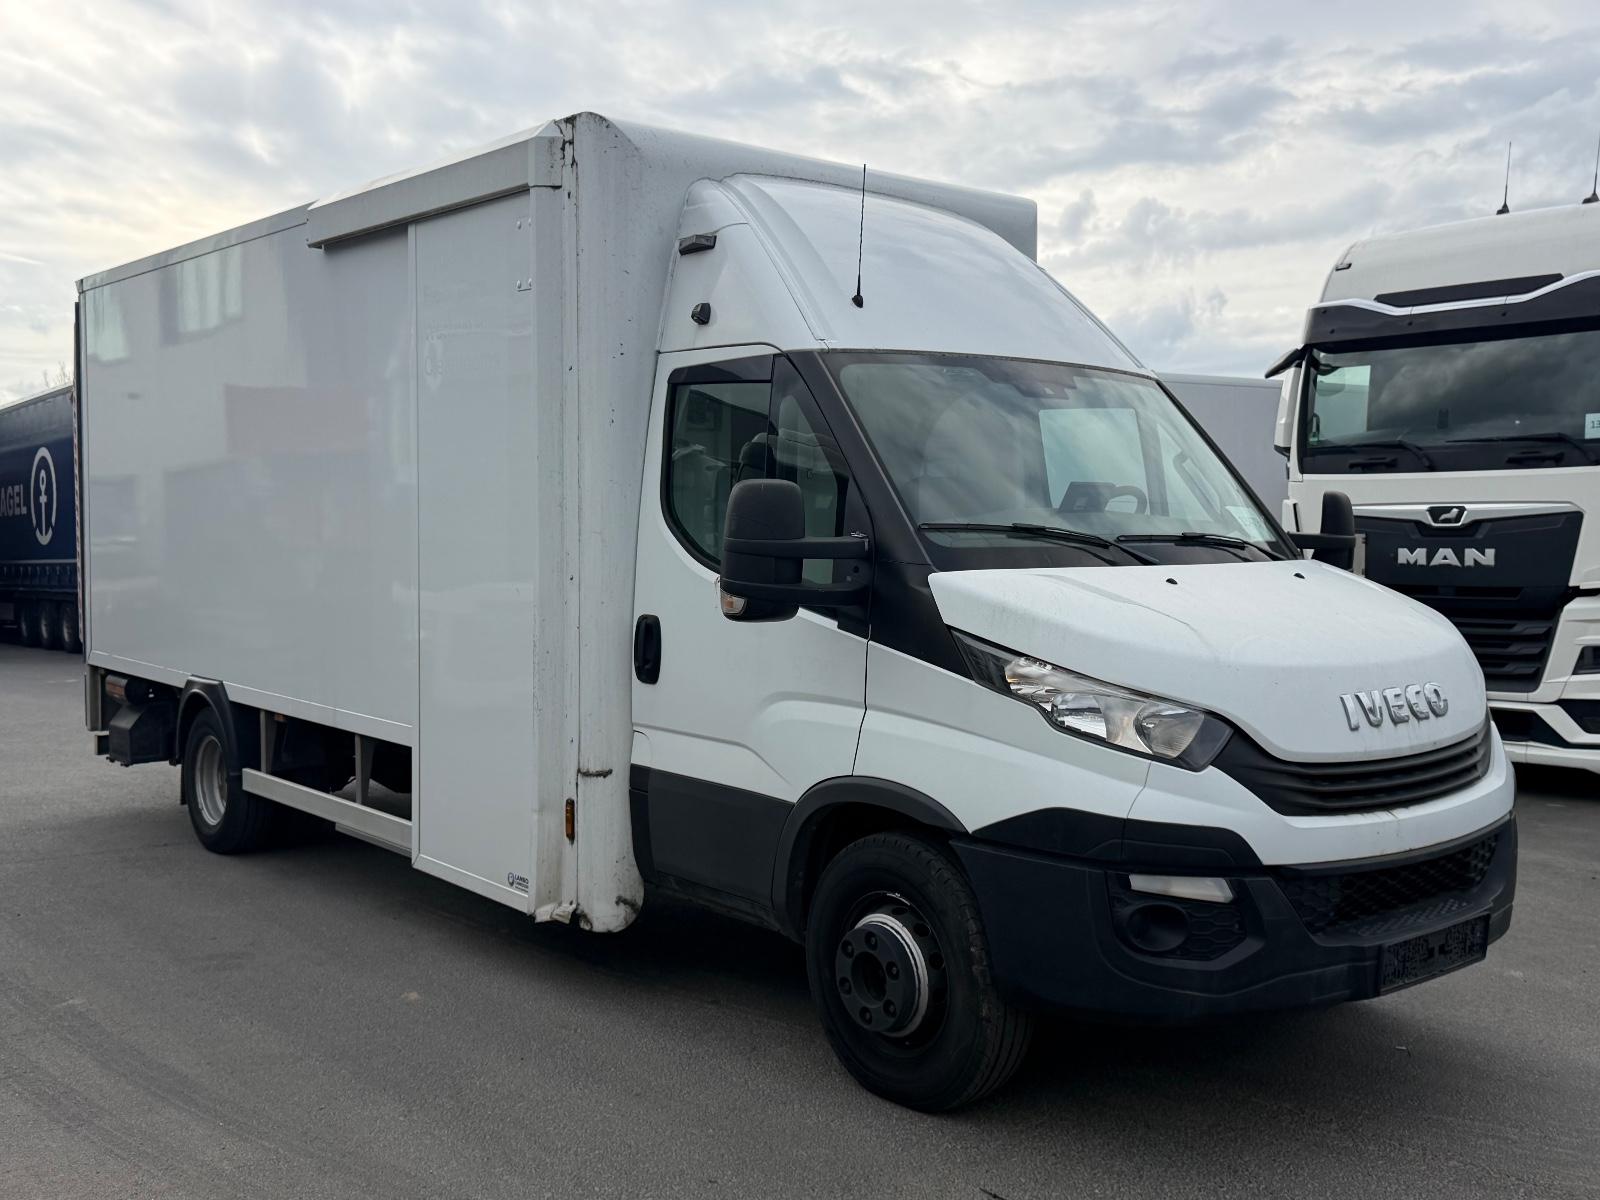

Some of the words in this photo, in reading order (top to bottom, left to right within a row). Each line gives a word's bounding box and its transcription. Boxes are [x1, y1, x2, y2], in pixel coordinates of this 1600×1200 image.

[0, 484, 27, 517] AGEL
[1397, 547, 1496, 567] MAN
[1339, 682, 1449, 731] IVECO
